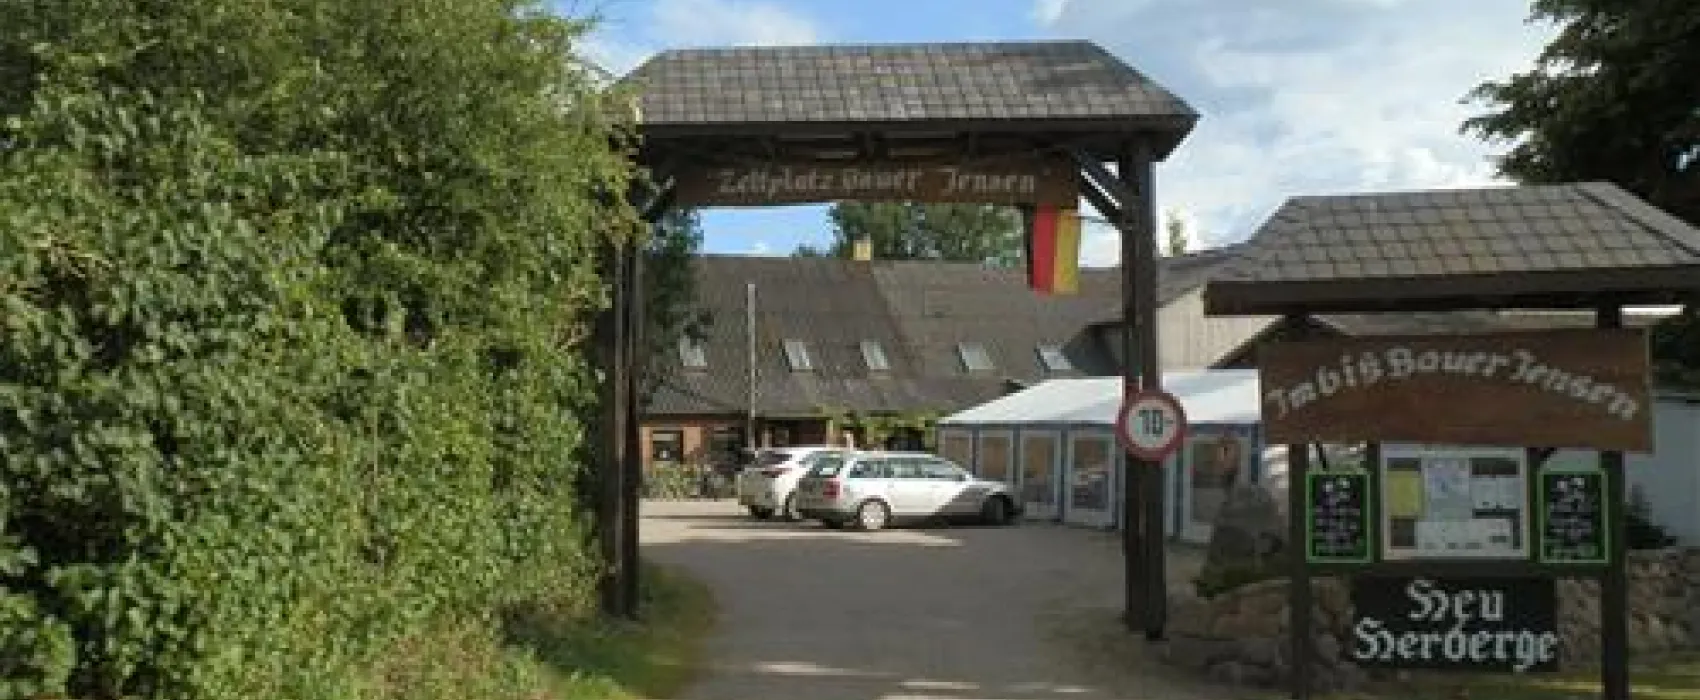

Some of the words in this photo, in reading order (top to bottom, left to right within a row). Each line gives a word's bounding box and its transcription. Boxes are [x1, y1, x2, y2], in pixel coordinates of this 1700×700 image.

[1386, 347, 1509, 378] Bauer
[1407, 579, 1503, 621] Heu
[1353, 616, 1558, 673] Herberge
